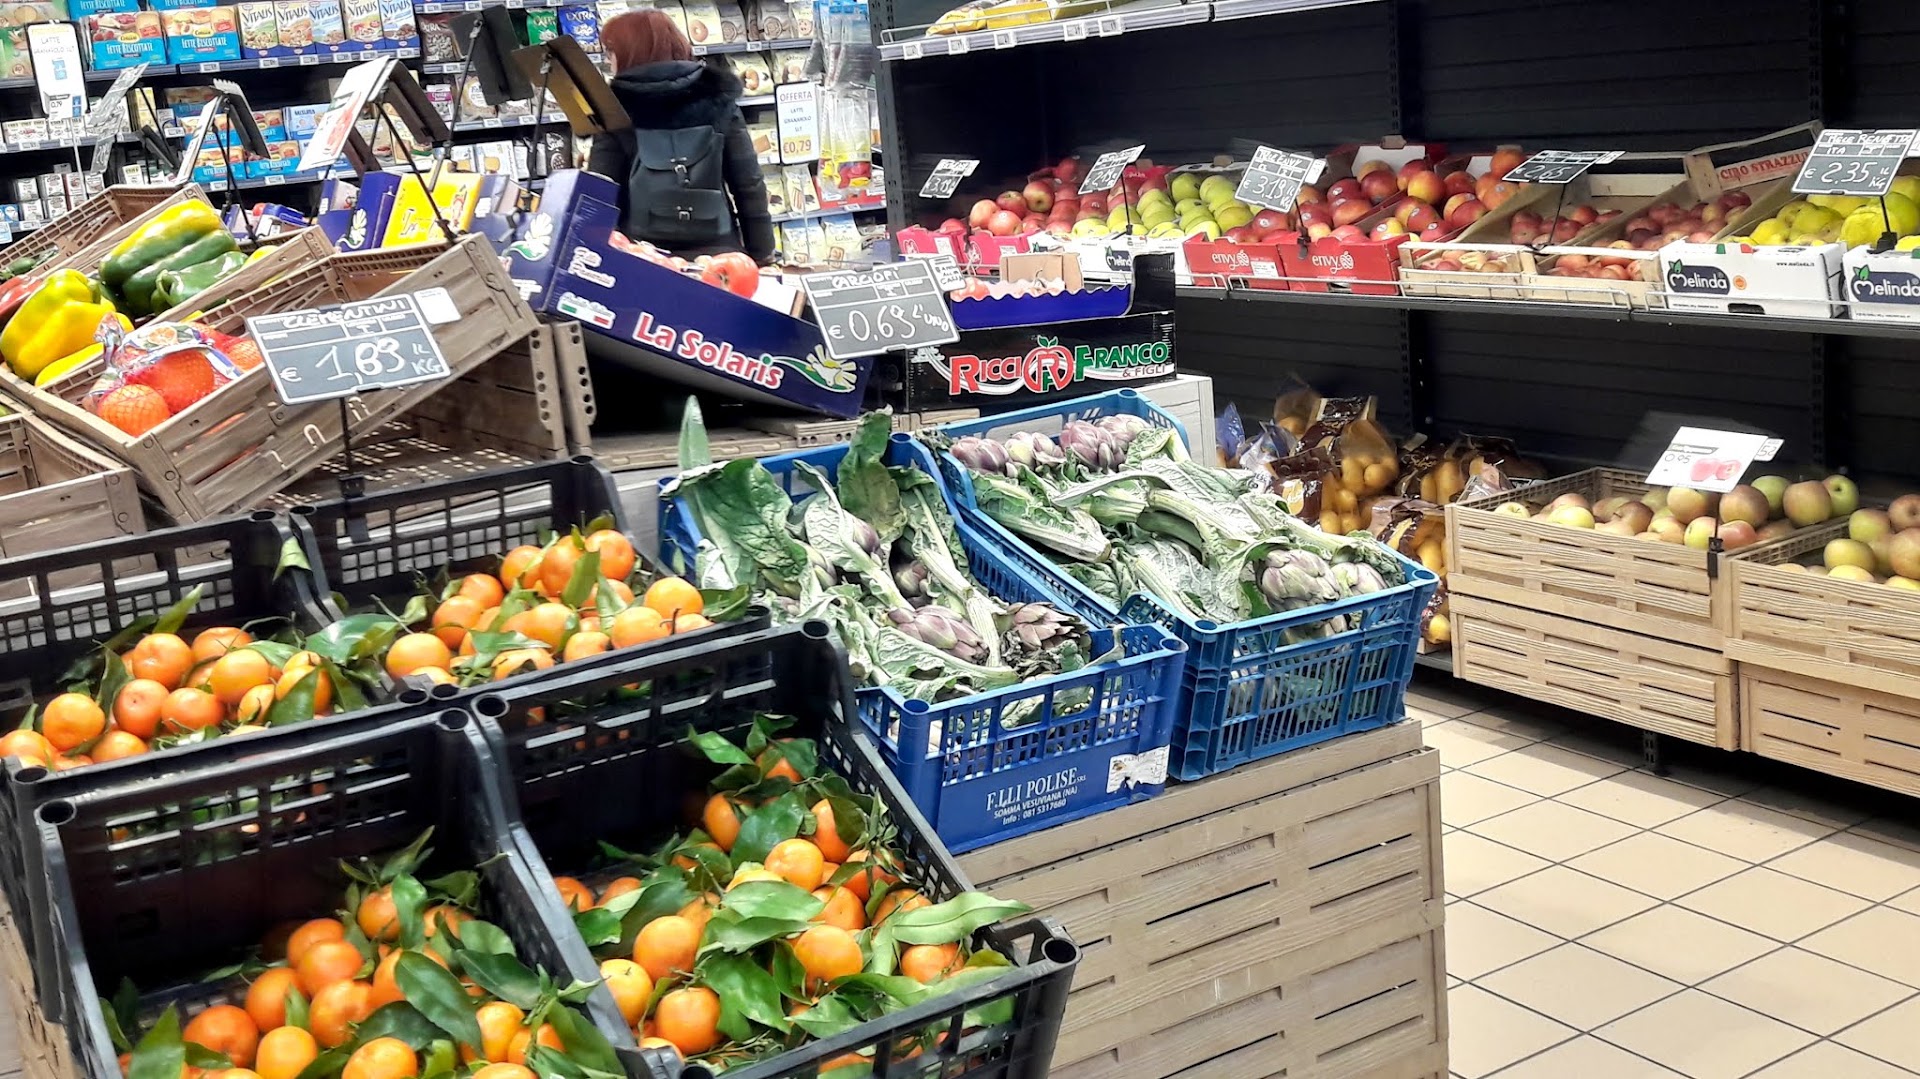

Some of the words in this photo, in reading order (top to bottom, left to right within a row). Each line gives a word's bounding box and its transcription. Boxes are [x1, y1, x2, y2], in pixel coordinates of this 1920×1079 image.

[780, 91, 812, 101] OFFERTA
[1720, 165, 1748, 179] CIRO
[1212, 253, 1240, 270] envy
[1312, 255, 1341, 274] envy
[1670, 272, 1728, 289] Melinda
[633, 311, 677, 351] La
[680, 329, 786, 390] Solaris
[1134, 364, 1166, 376] FIGLI
[986, 784, 1022, 811] F.LLI
[1026, 767, 1077, 798] POLISE
[994, 805, 1020, 819] SOMMA
[1022, 790, 1062, 810] VESUVIANA
